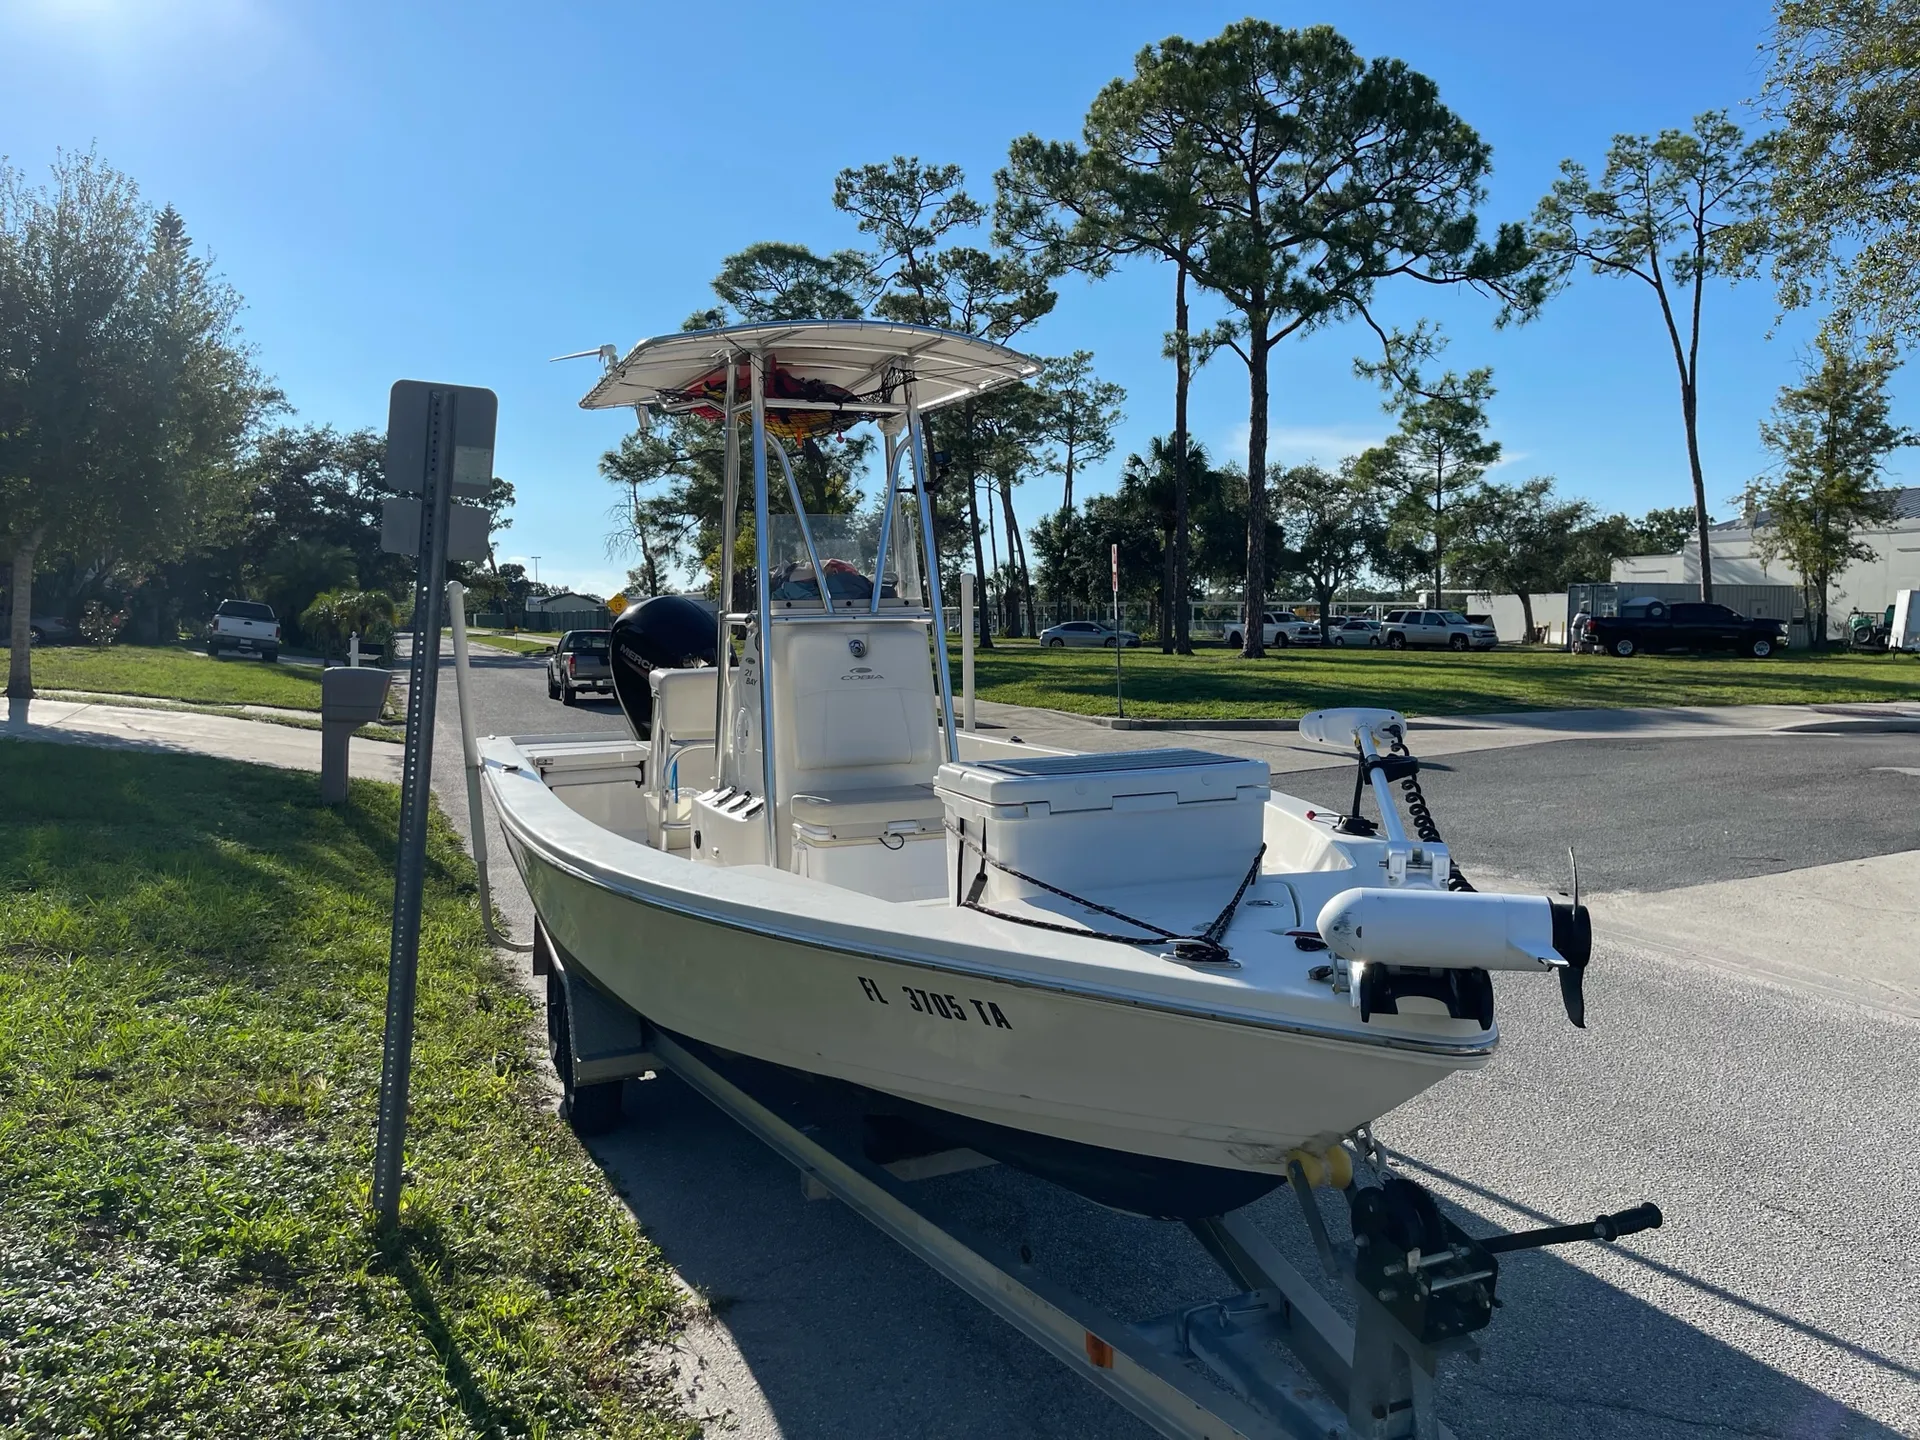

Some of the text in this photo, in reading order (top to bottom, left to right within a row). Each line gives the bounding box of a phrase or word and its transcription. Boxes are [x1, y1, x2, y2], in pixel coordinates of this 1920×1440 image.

[620, 644, 659, 671] MERCU
[744, 668, 753, 676] 21
[745, 677, 758, 686] BAY
[857, 976, 1014, 1030] FL 3705 TA
